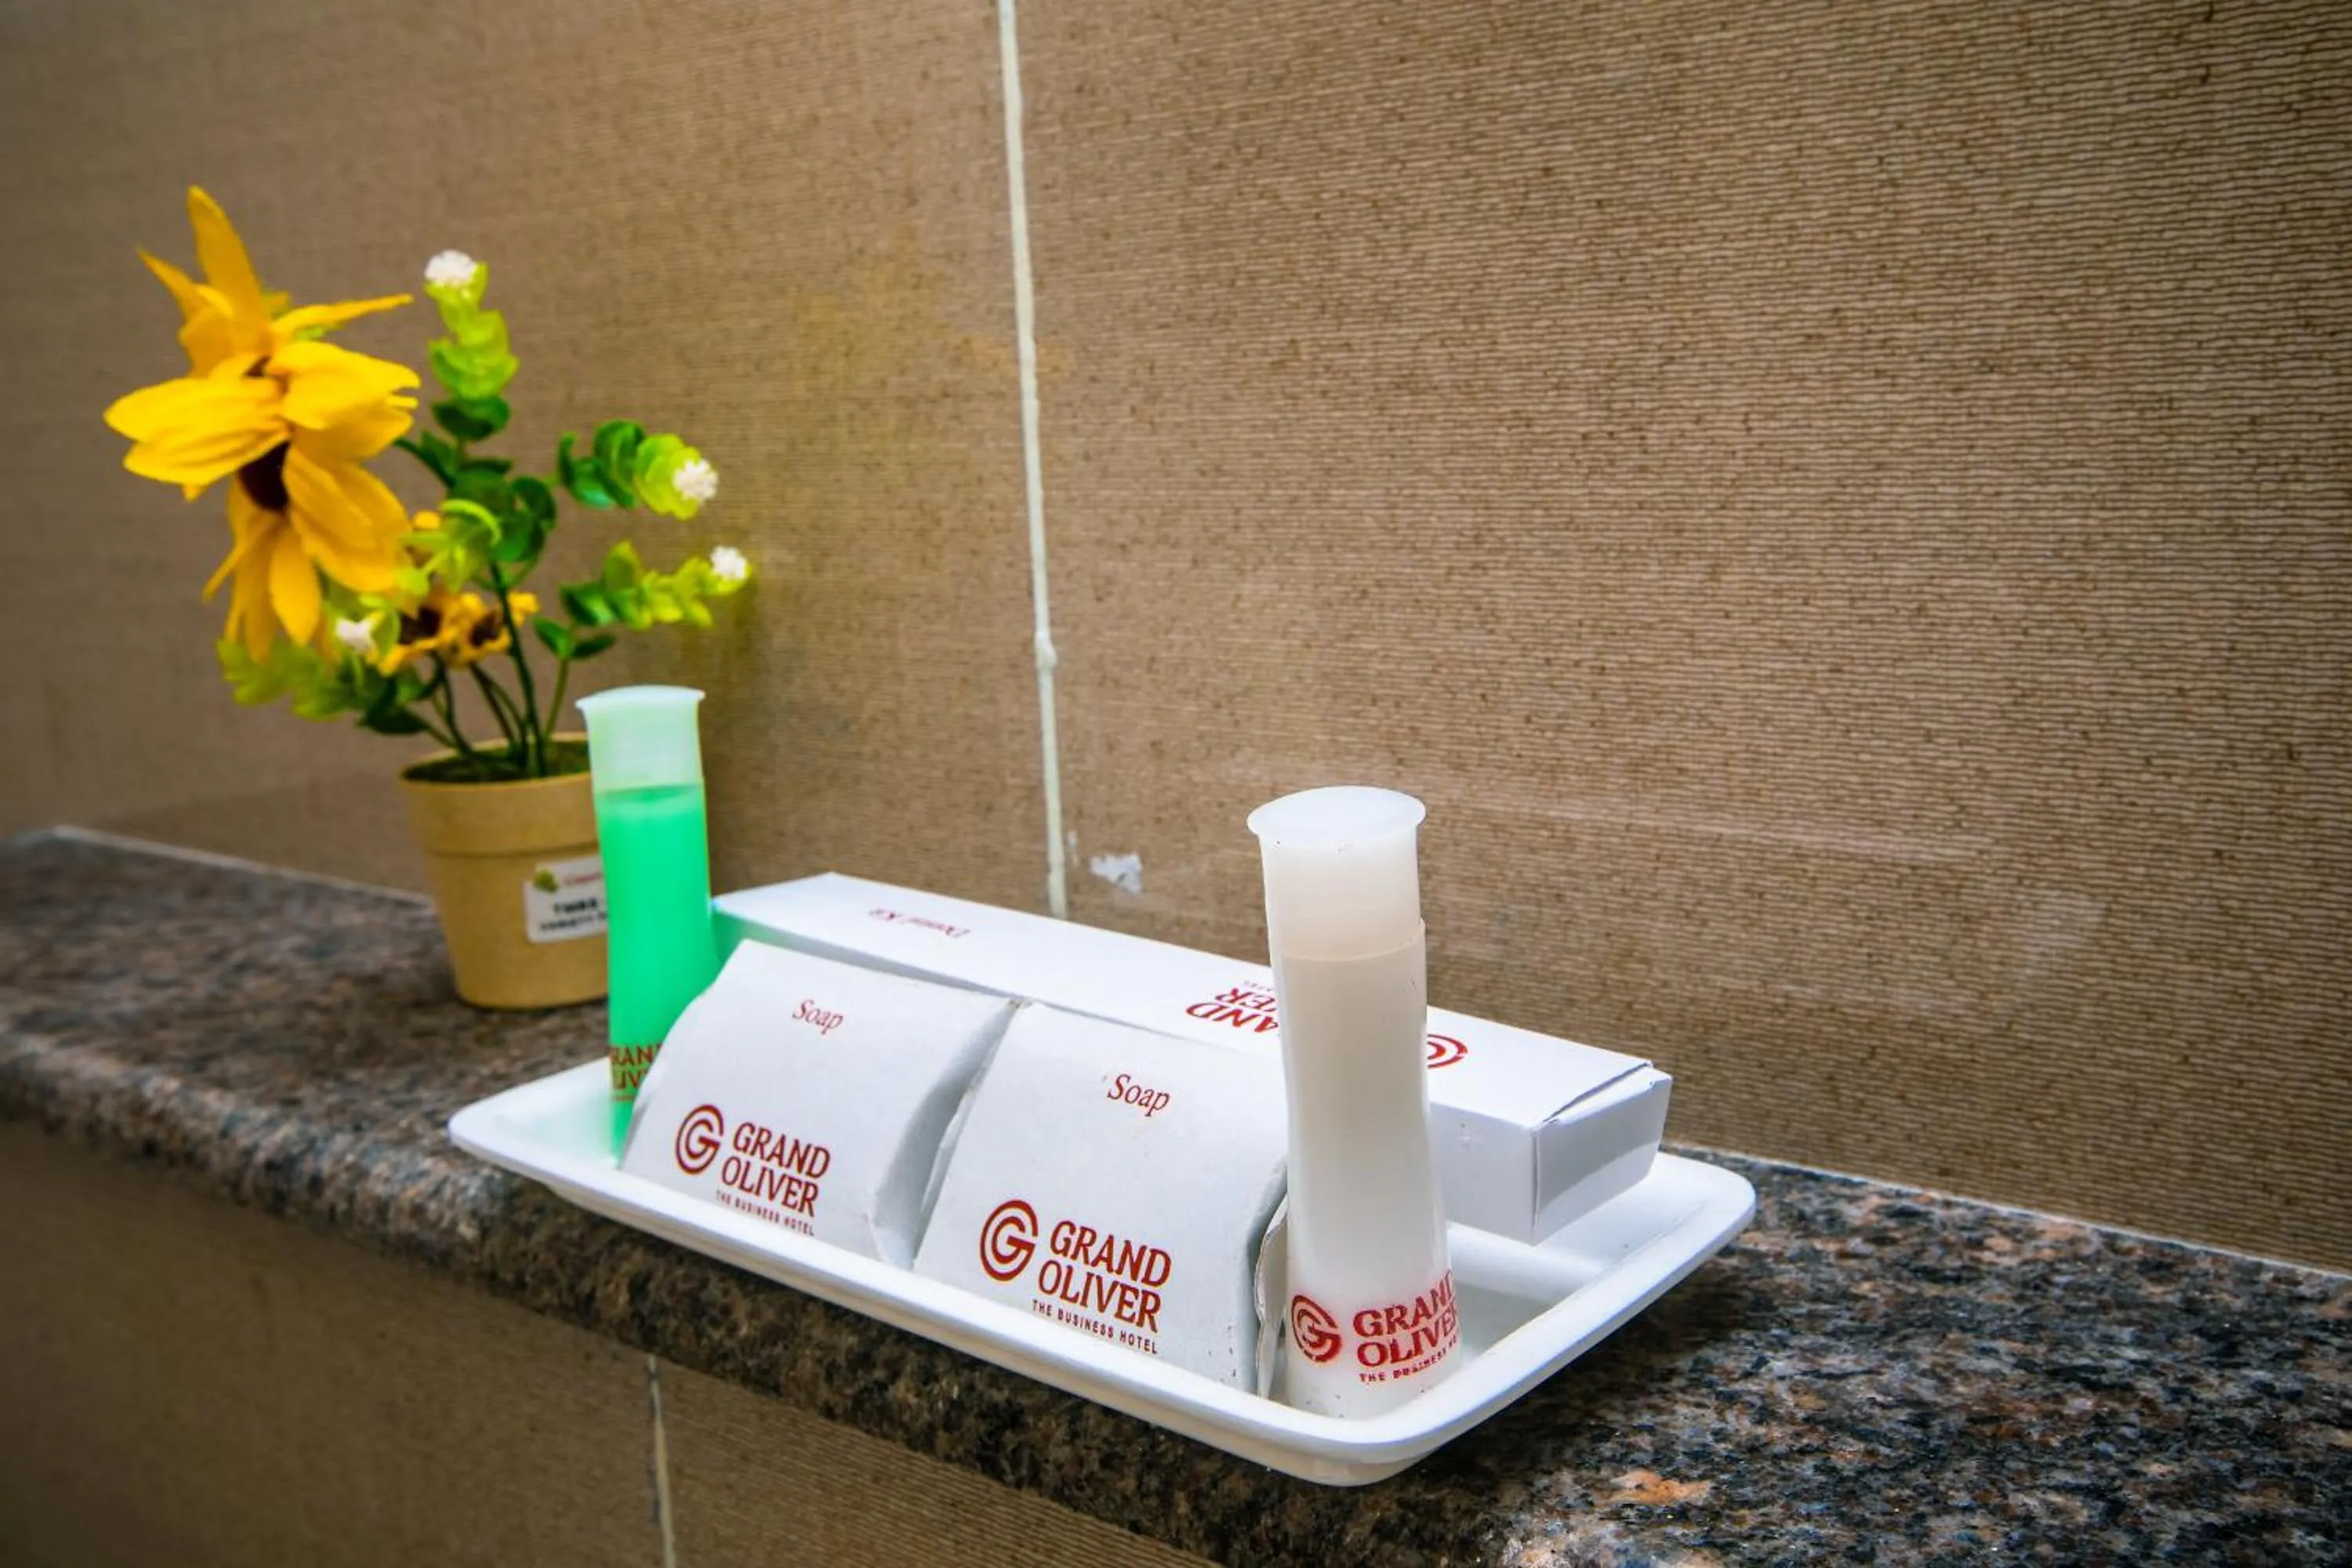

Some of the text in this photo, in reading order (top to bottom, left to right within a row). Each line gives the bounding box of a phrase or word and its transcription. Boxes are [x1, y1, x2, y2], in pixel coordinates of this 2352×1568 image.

[791, 998, 844, 1036] Soap
[1185, 1001, 1279, 1033] AND
[1214, 987, 1277, 1012] ER
[1106, 1073, 1171, 1117] Soap
[731, 1122, 831, 1179] GRAND
[721, 1156, 819, 1218] OLIVER
[1050, 1220, 1172, 1288] GRAND
[1038, 1259, 1161, 1333] OLIVER
[1032, 1299, 1157, 1355] THE BUSINESS HOTEL
[1359, 1373, 1386, 1382] THE
